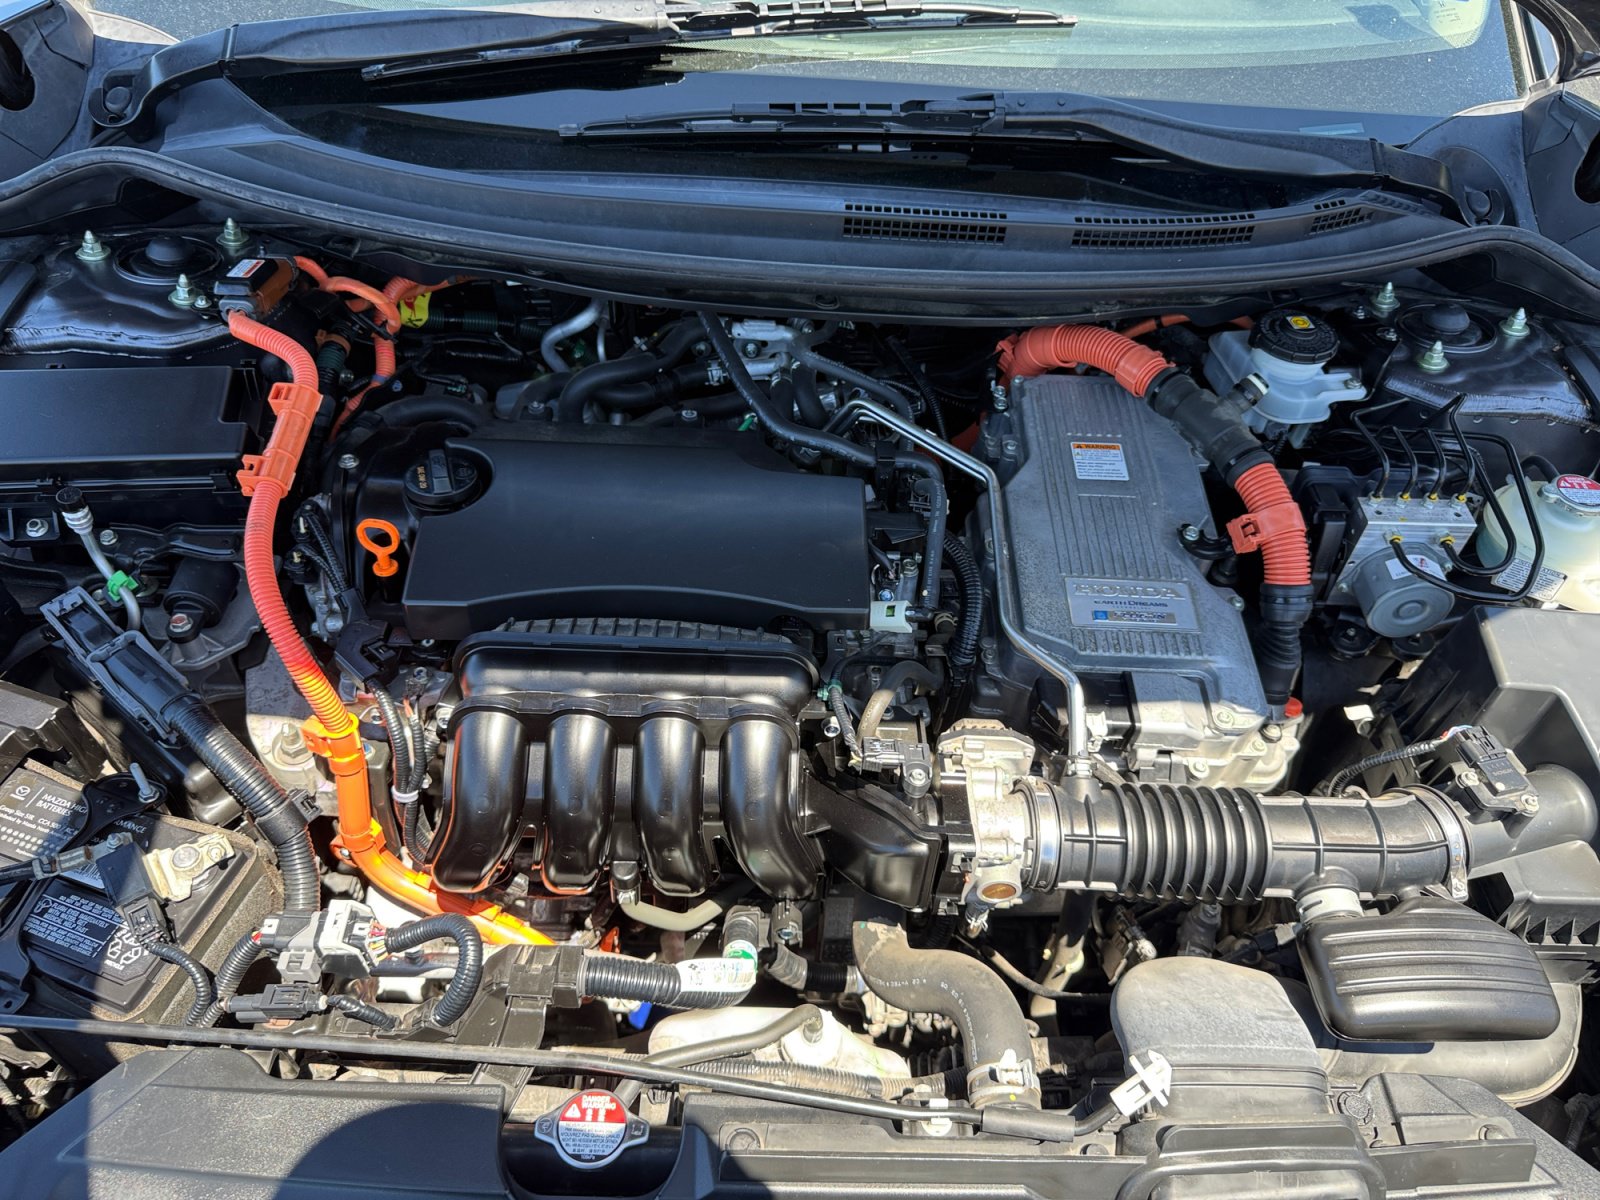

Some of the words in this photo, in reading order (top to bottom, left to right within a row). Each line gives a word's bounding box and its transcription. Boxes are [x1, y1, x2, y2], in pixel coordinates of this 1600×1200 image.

[1073, 584, 1186, 600] HONDA
[36, 799, 73, 818] BATTERIES
[42, 793, 71, 808] MAZDA
[48, 908, 62, 916] WITH
[52, 903, 69, 913] FLUSH
[67, 909, 80, 917] EYES
[78, 913, 110, 929] IMMEDIATELY
[43, 913, 64, 924] MEDICAL
[63, 920, 77, 929] HELP
